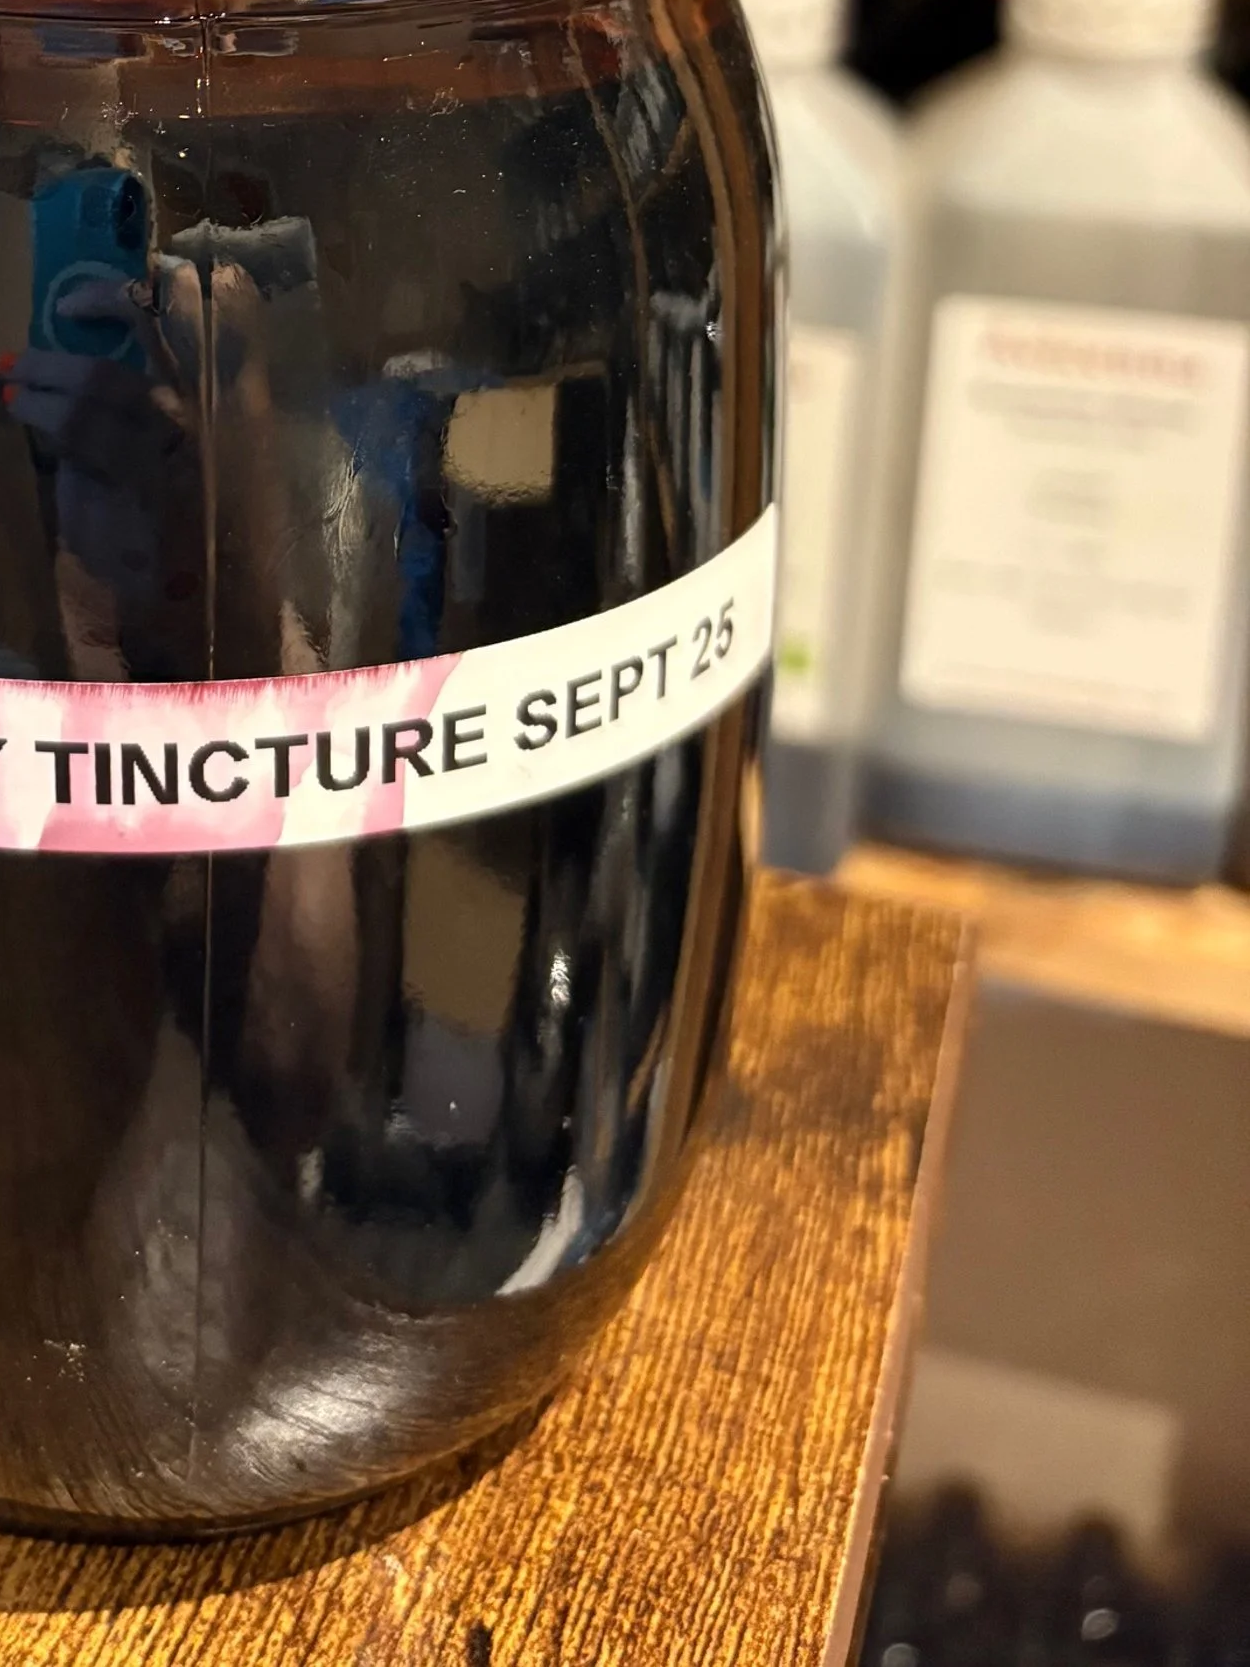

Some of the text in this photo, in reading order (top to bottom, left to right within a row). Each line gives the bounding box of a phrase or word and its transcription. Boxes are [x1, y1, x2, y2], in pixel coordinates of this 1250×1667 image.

[34, 703, 489, 808] TINCTURE
[515, 635, 679, 752] SEPT
[688, 598, 737, 676] 25
